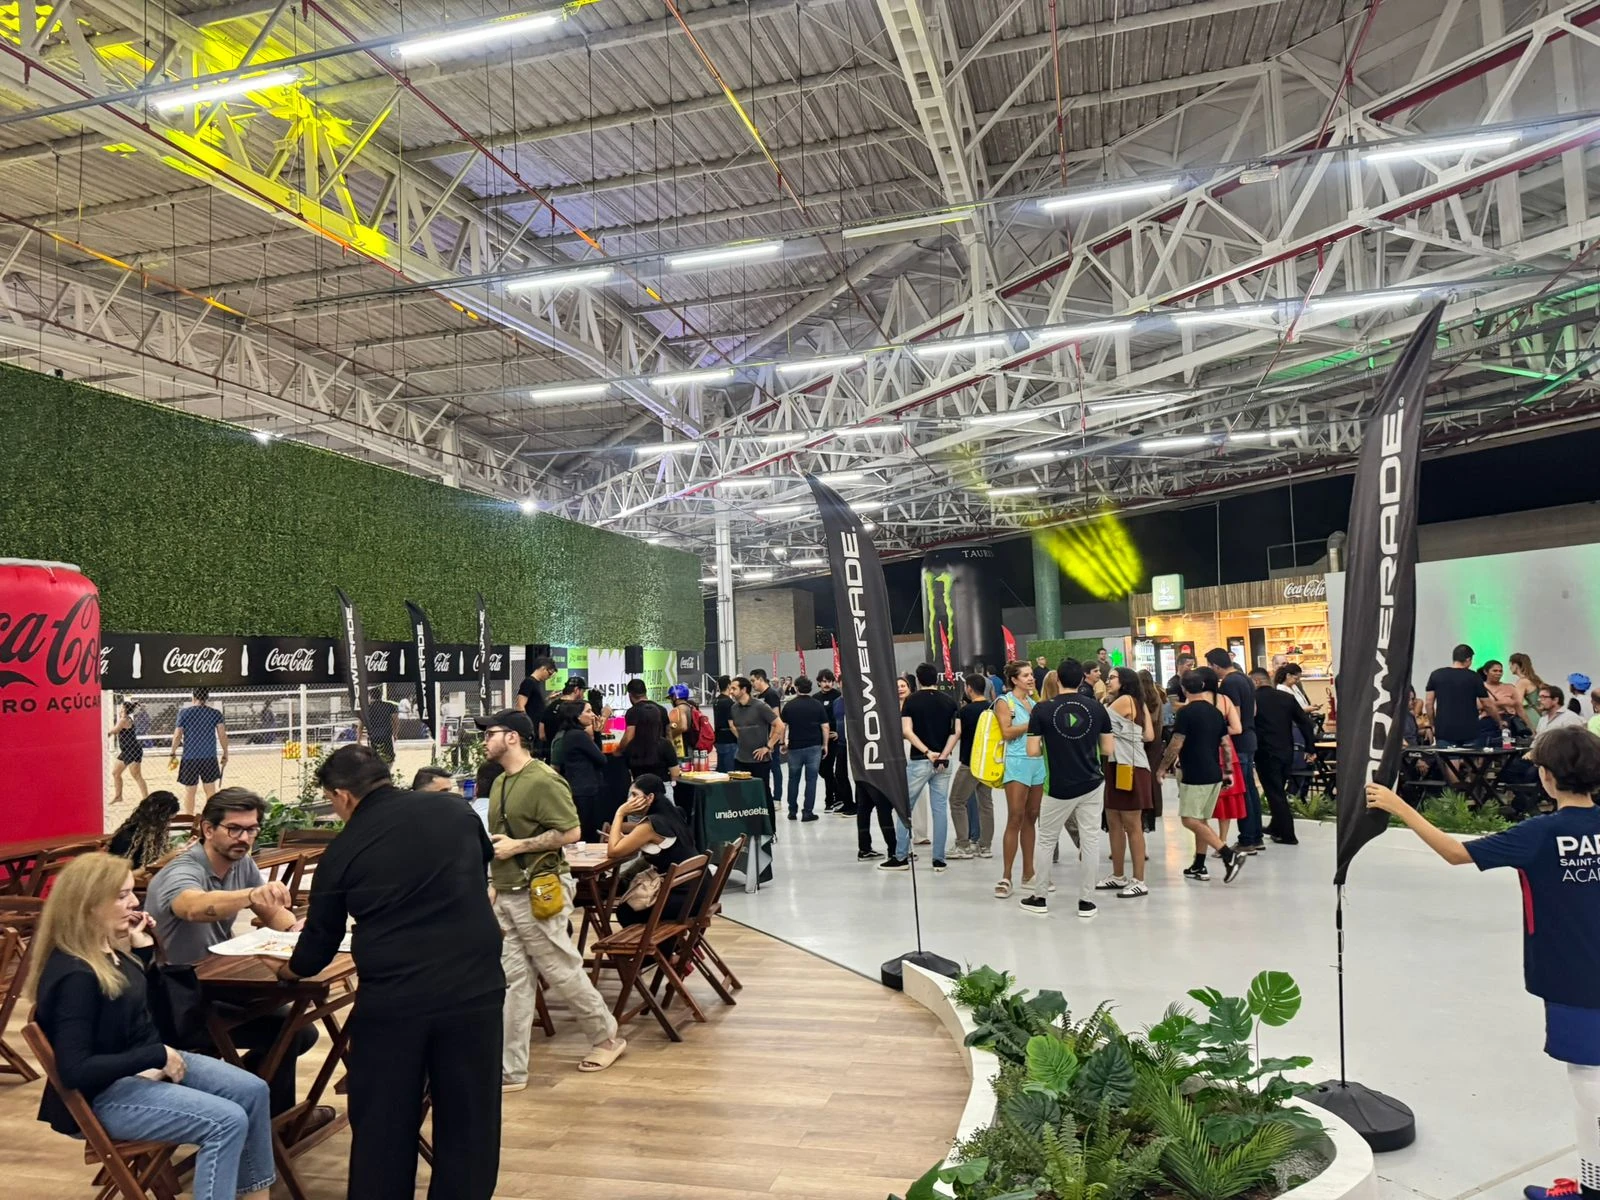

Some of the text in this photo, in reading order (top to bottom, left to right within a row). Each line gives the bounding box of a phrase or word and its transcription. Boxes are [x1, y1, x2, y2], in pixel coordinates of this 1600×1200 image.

[1284, 579, 1326, 598] Coca-Cola
[163, 647, 227, 674] Coca-Cola
[265, 647, 317, 673] Coca-Cola
[840, 530, 885, 770] POWERADE
[46, 692, 101, 713] AÇÚCA
[715, 809, 738, 820] união
[1562, 868, 1600, 883] ACA
